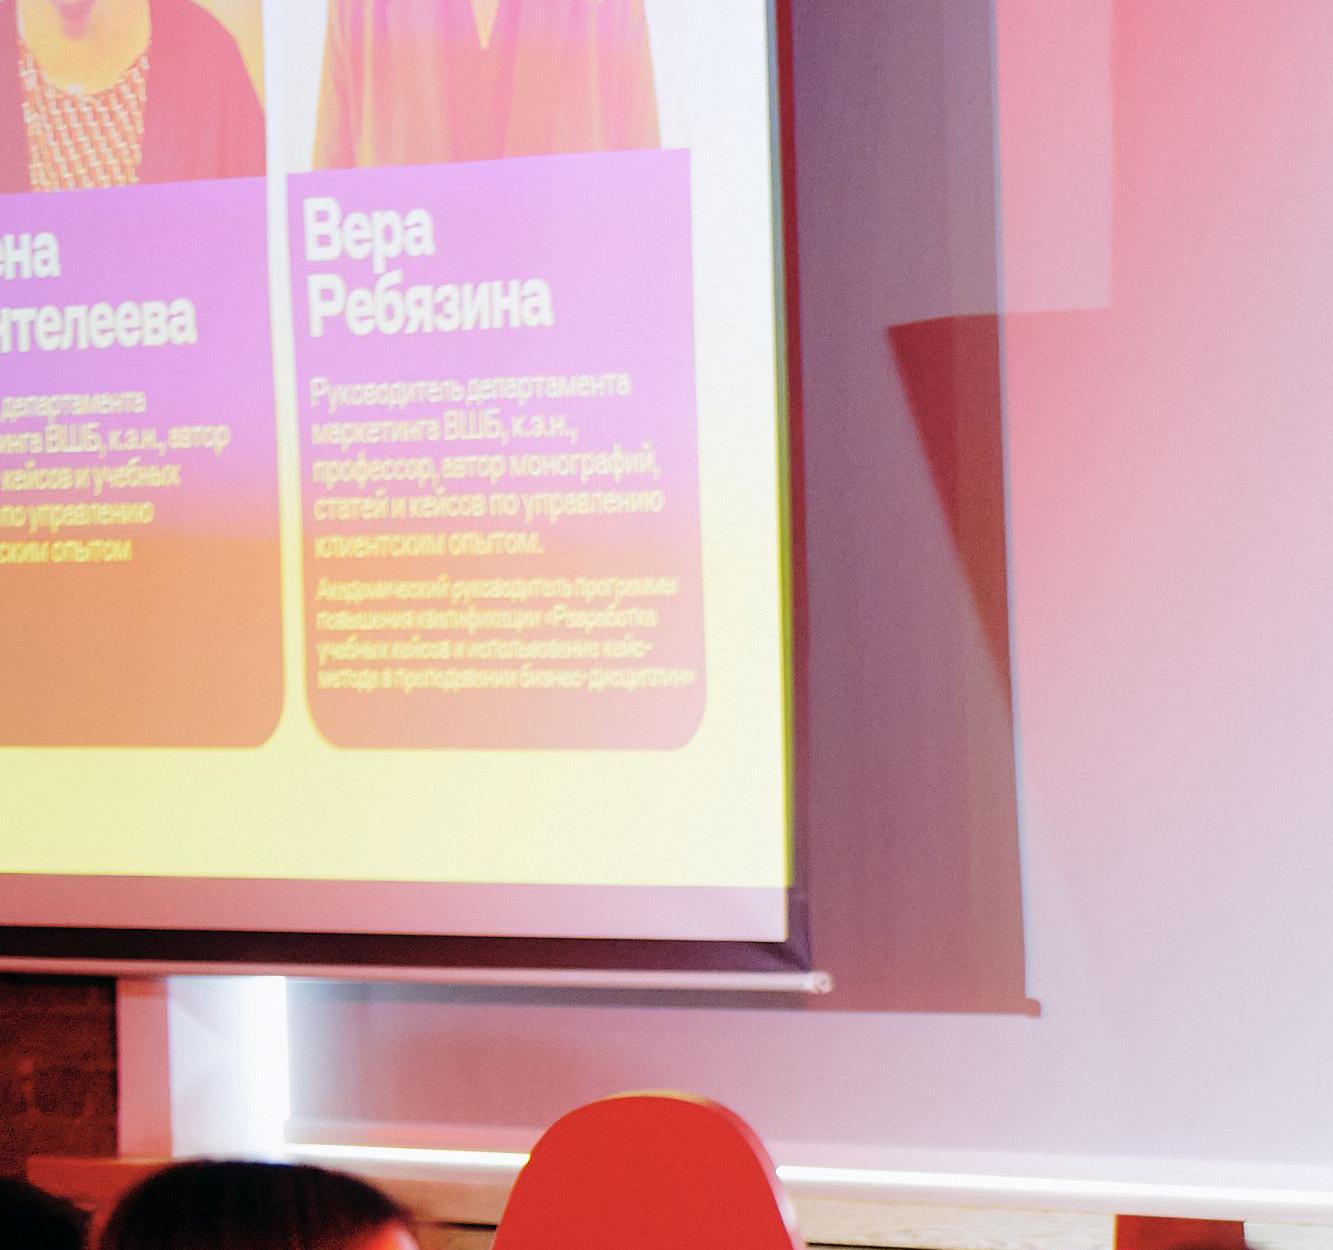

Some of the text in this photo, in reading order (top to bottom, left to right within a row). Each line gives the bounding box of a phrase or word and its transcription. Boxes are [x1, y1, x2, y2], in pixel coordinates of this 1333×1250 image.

[0, 232, 61, 280] на
[303, 197, 436, 275] Вера
[306, 269, 554, 337] Ребязина
[309, 373, 633, 414] Руководитель департамента
[45, 422, 107, 459] ВШБ,
[311, 419, 440, 451] маркетинга
[443, 408, 510, 446] ВШБ,
[312, 440, 662, 489] профессор, автор монографий,
[313, 486, 666, 524] статей и кейсов по управлению
[314, 533, 447, 558] клиентским
